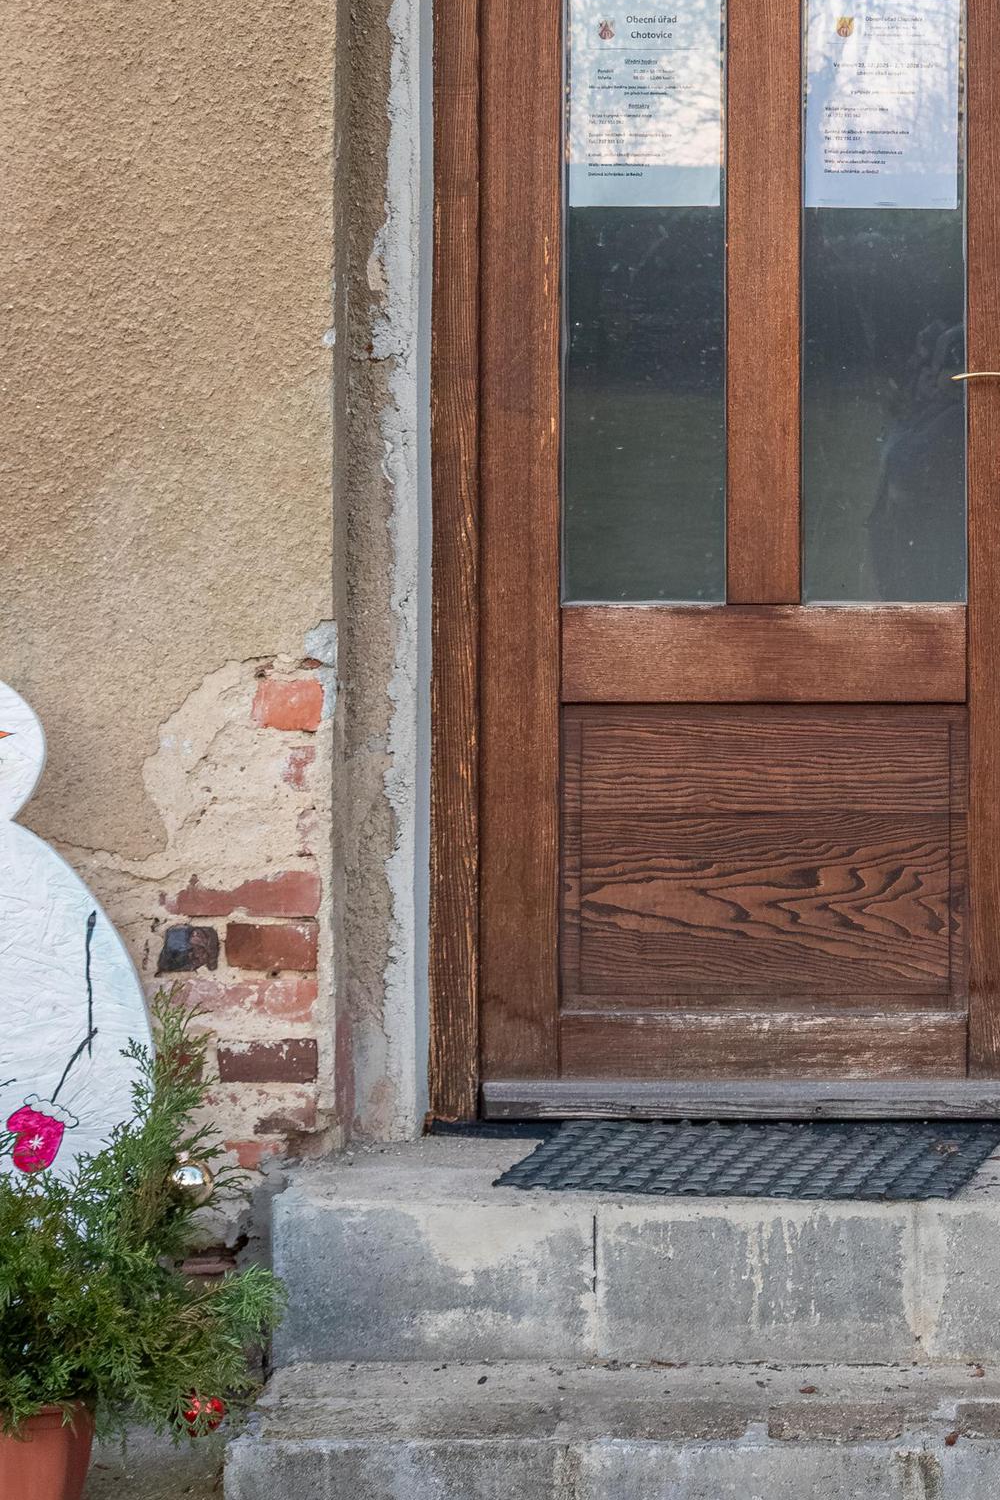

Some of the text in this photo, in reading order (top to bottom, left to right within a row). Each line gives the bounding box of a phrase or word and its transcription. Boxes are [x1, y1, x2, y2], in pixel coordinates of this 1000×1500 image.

[626, 15, 677, 24] Obecní úřad
[630, 30, 673, 39] Chotovice
